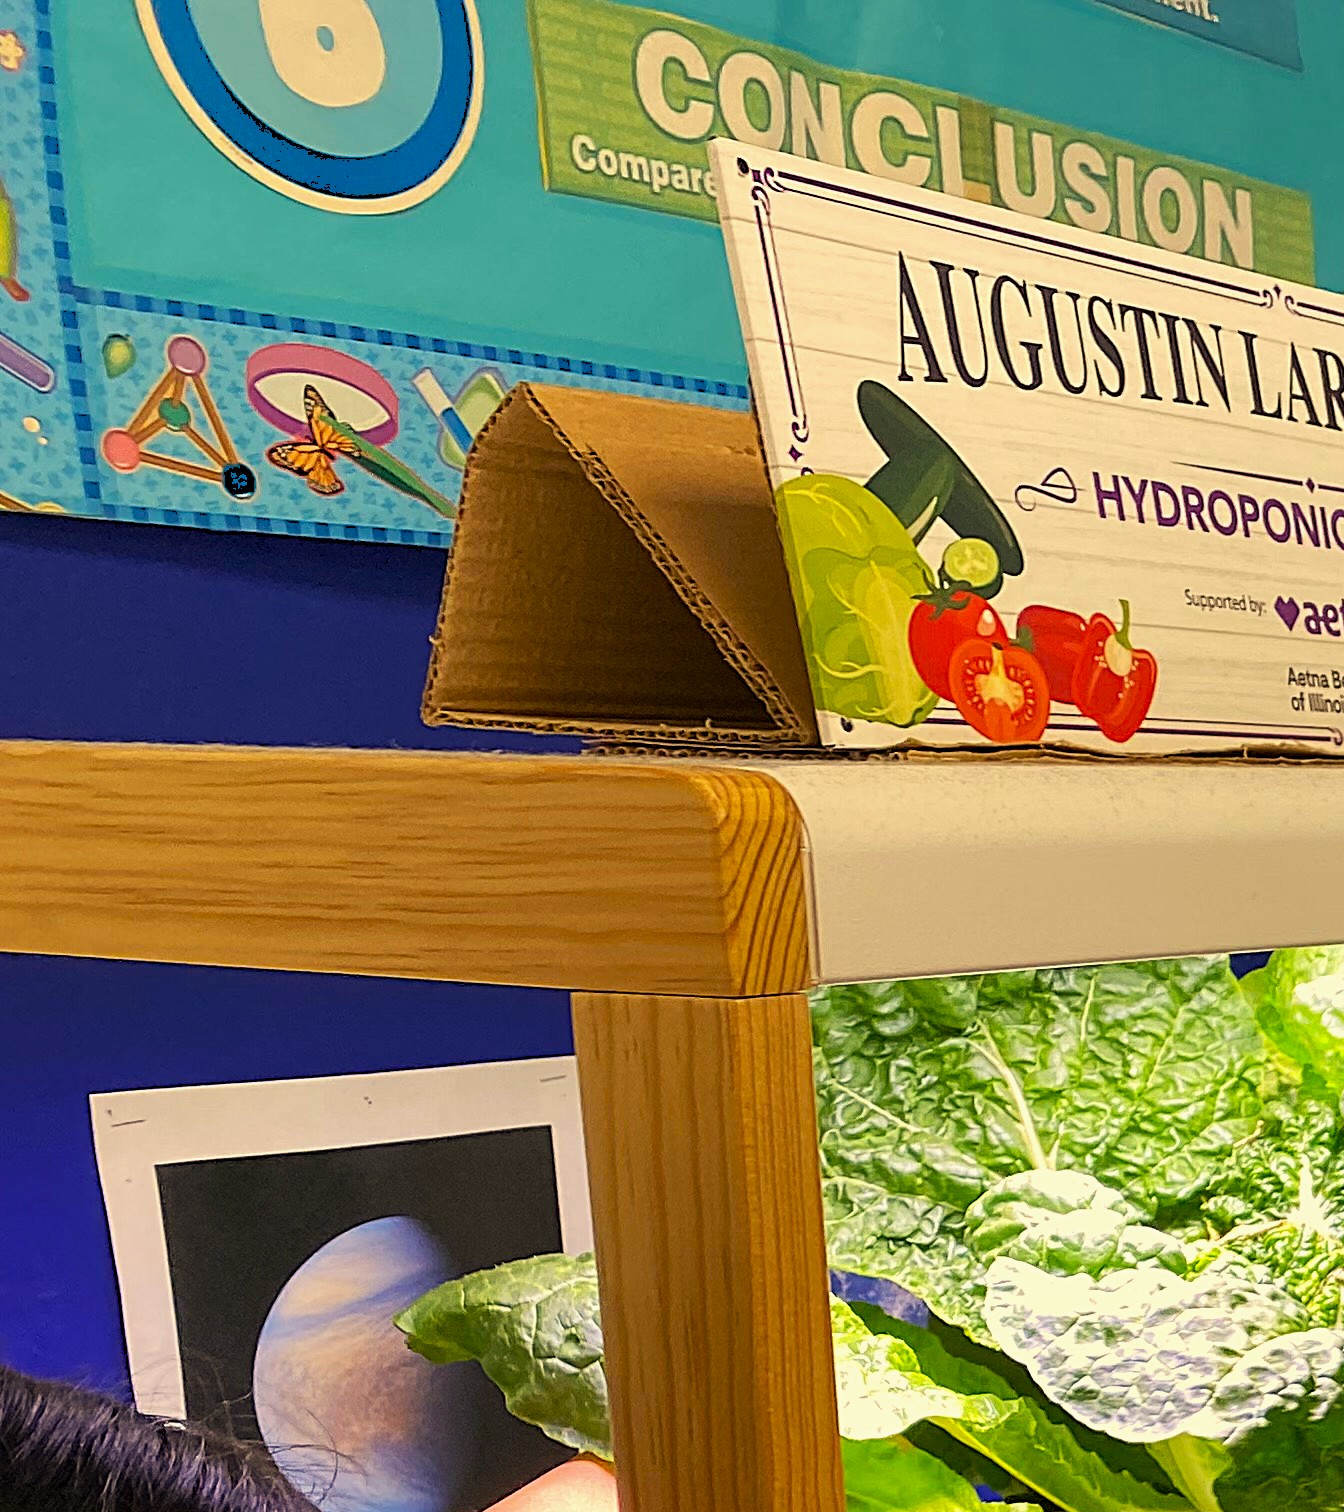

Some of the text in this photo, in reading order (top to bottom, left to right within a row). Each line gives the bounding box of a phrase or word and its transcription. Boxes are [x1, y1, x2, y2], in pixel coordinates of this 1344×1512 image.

[636, 29, 1254, 269] CONCLUSION
[898, 250, 1231, 412] AUGUSTIN
[1184, 588, 1247, 613] Supported
[1287, 666, 1331, 690] Aetna
[1291, 691, 1306, 712] of
